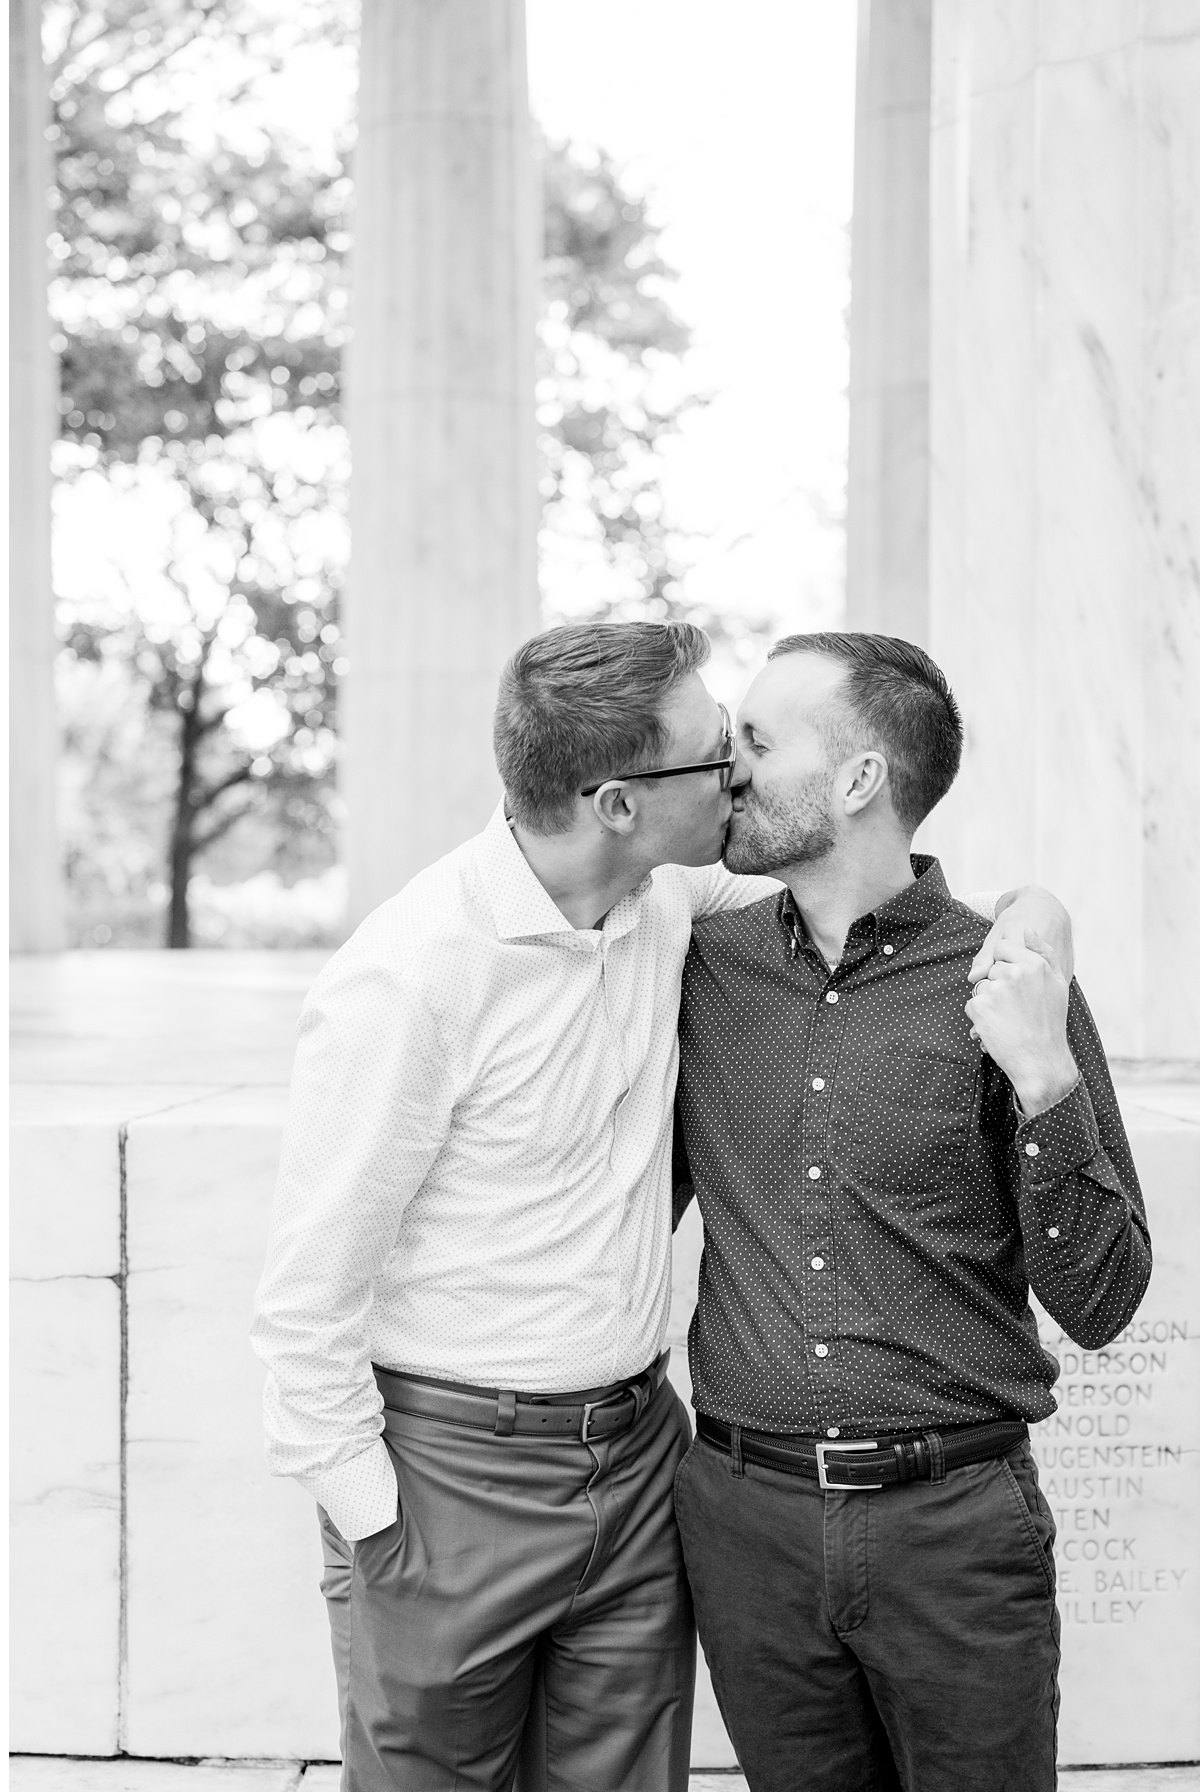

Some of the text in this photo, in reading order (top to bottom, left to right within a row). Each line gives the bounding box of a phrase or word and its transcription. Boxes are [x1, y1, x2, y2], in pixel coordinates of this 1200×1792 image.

[1056, 1352, 1167, 1376] DERSON
[1031, 1415, 1131, 1438] RNOLD
[1045, 1476, 1144, 1500] AUSTIN
[1055, 1508, 1111, 1531] TEN
[1053, 1537, 1138, 1562] COCK
[1058, 1569, 1188, 1593] E. BAILEY
[1065, 1600, 1144, 1625] ILLEY
